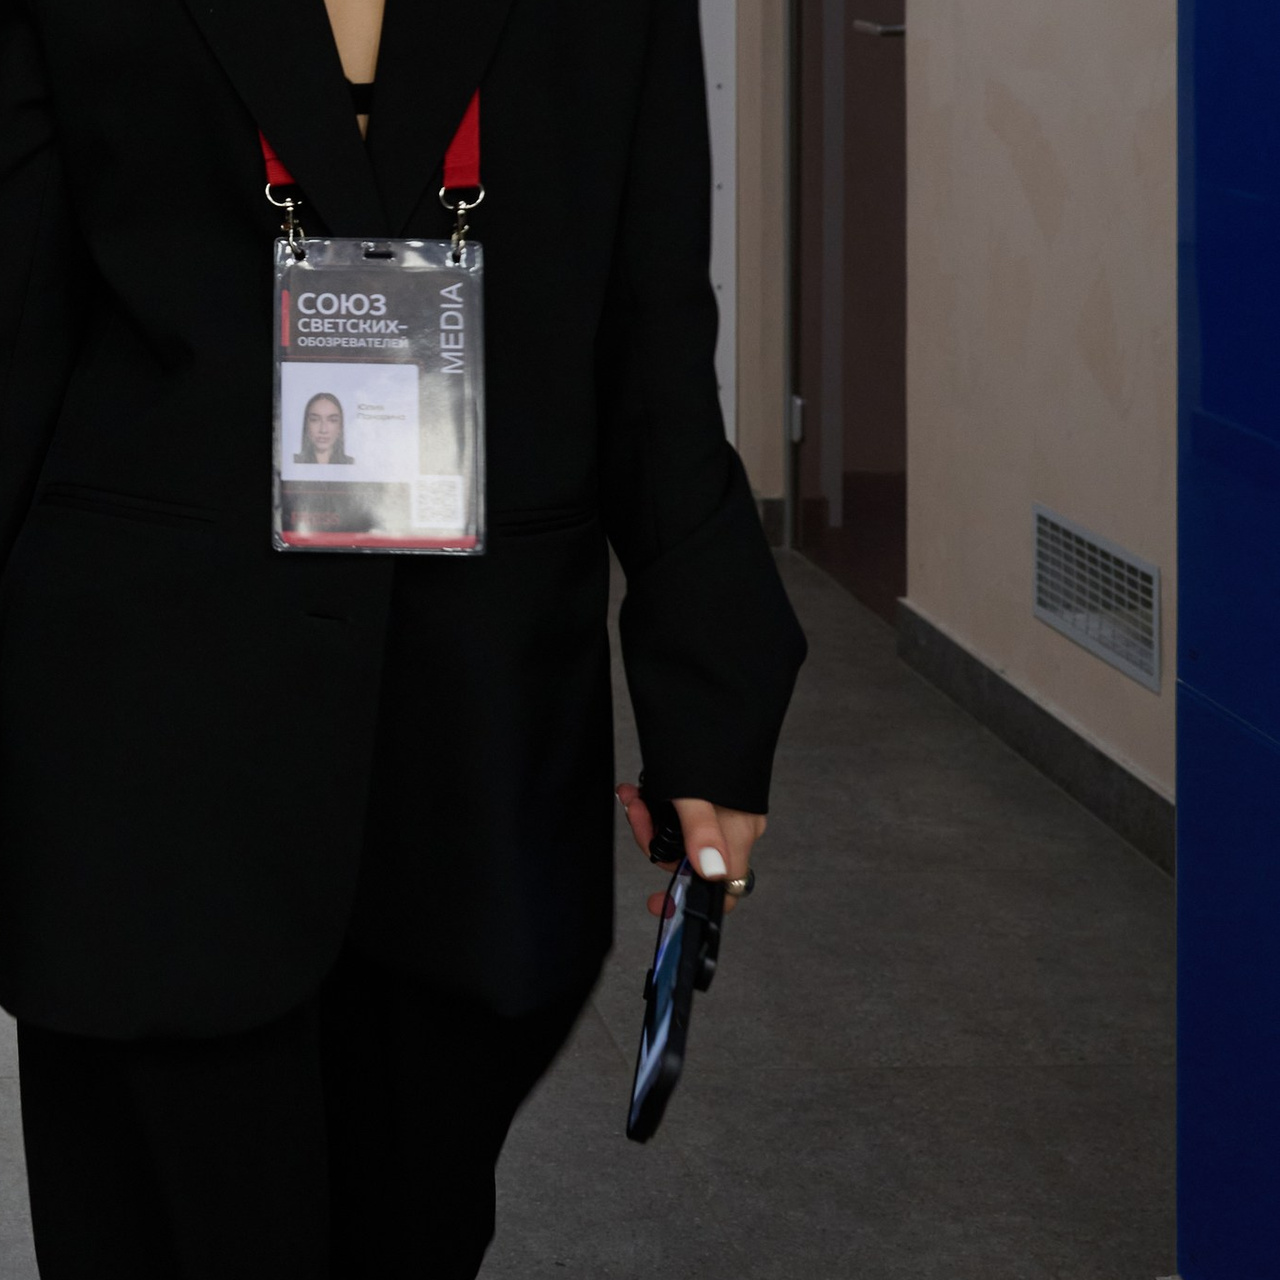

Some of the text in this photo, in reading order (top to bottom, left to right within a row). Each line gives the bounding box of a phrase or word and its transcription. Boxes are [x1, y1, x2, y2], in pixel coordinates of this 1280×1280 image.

[297, 292, 387, 316] СОЮЗ
[297, 318, 408, 334] СВЕТСКИХ-
[440, 282, 464, 374] MEDIA
[297, 336, 409, 348] ОБОЗРЕВАТЕЛЕЙ
